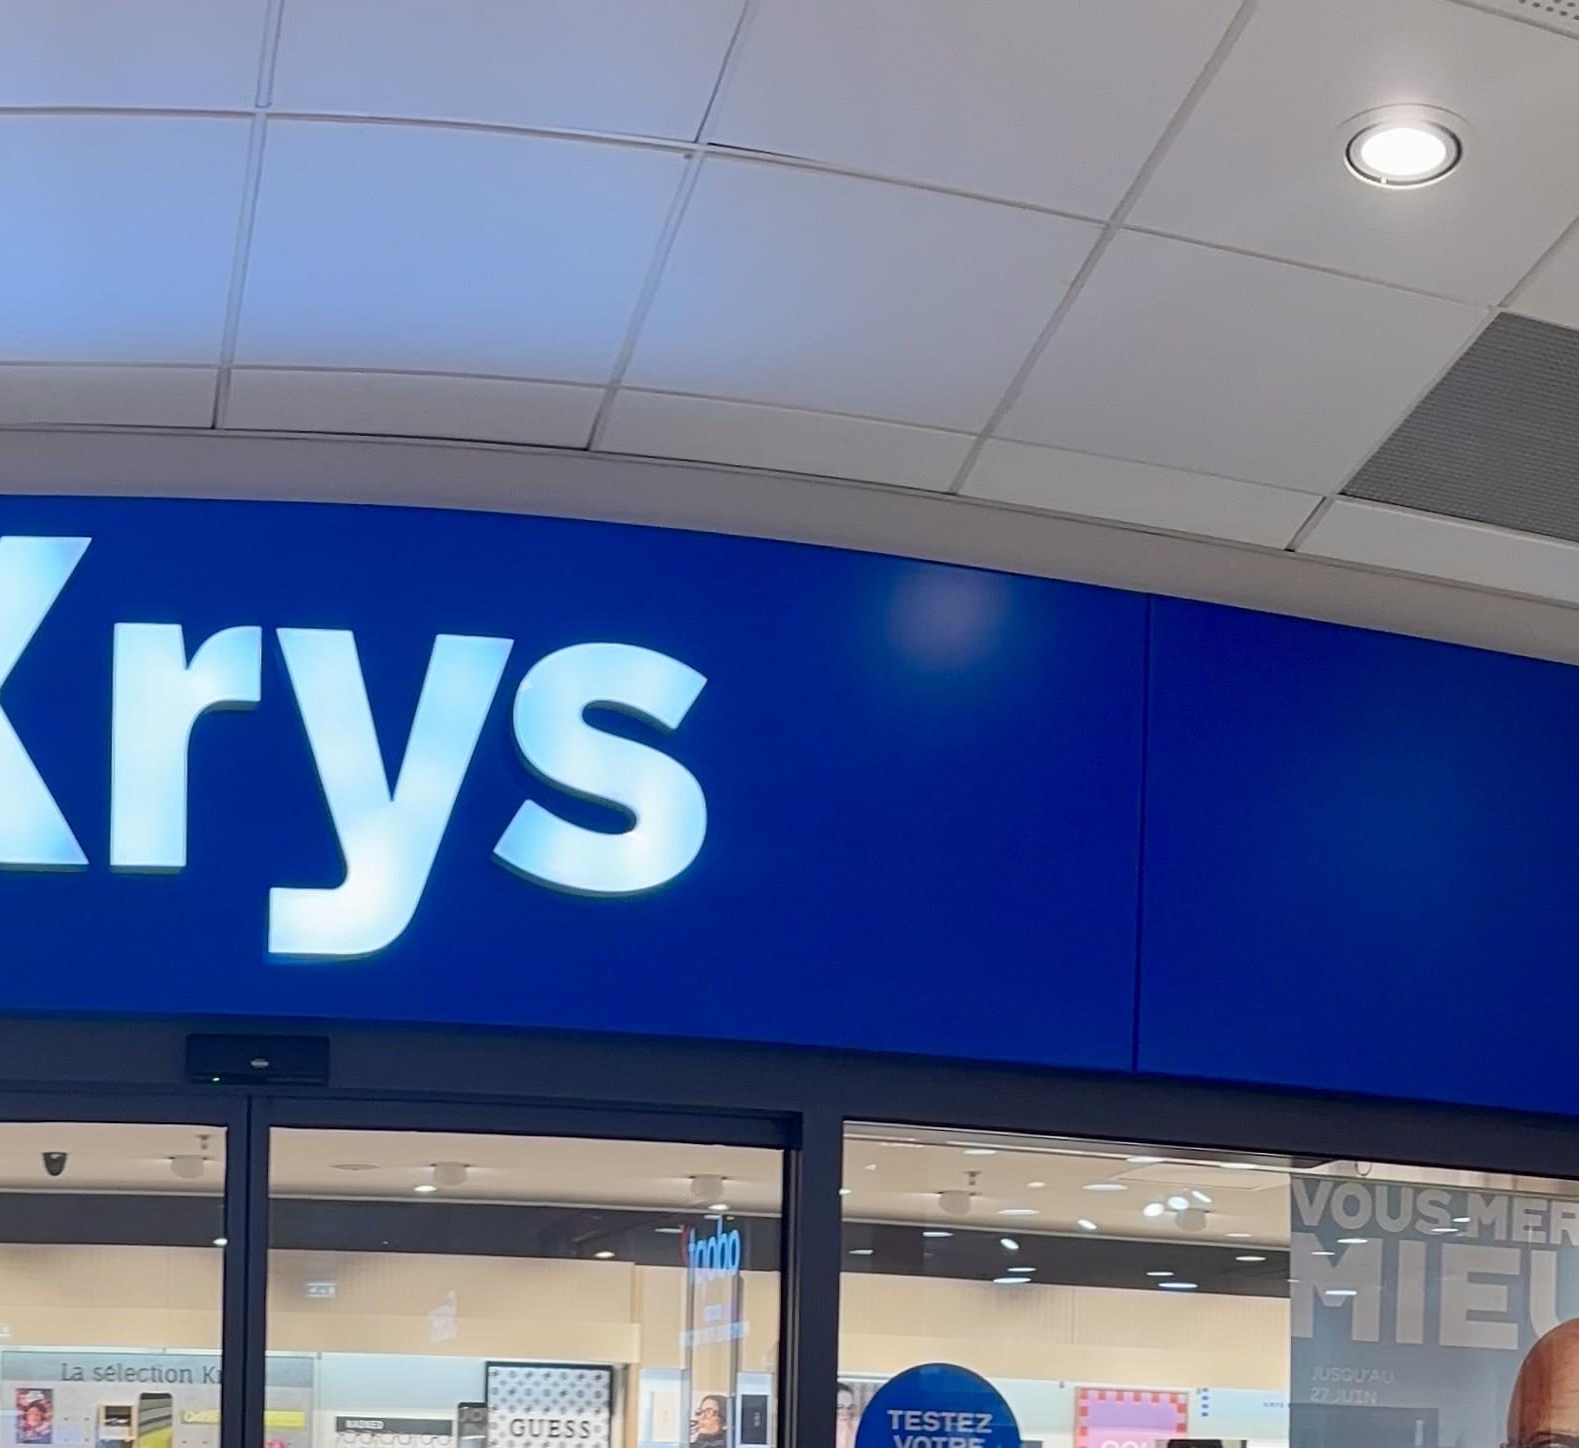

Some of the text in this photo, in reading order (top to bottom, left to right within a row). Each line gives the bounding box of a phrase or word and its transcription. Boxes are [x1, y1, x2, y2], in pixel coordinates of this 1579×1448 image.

[1292, 1181, 1452, 1234] VOUS
[60, 1362, 85, 1382] La
[92, 1362, 194, 1384] sélection
[510, 1418, 590, 1439] GUESS
[886, 1409, 994, 1434] TESTEZ
